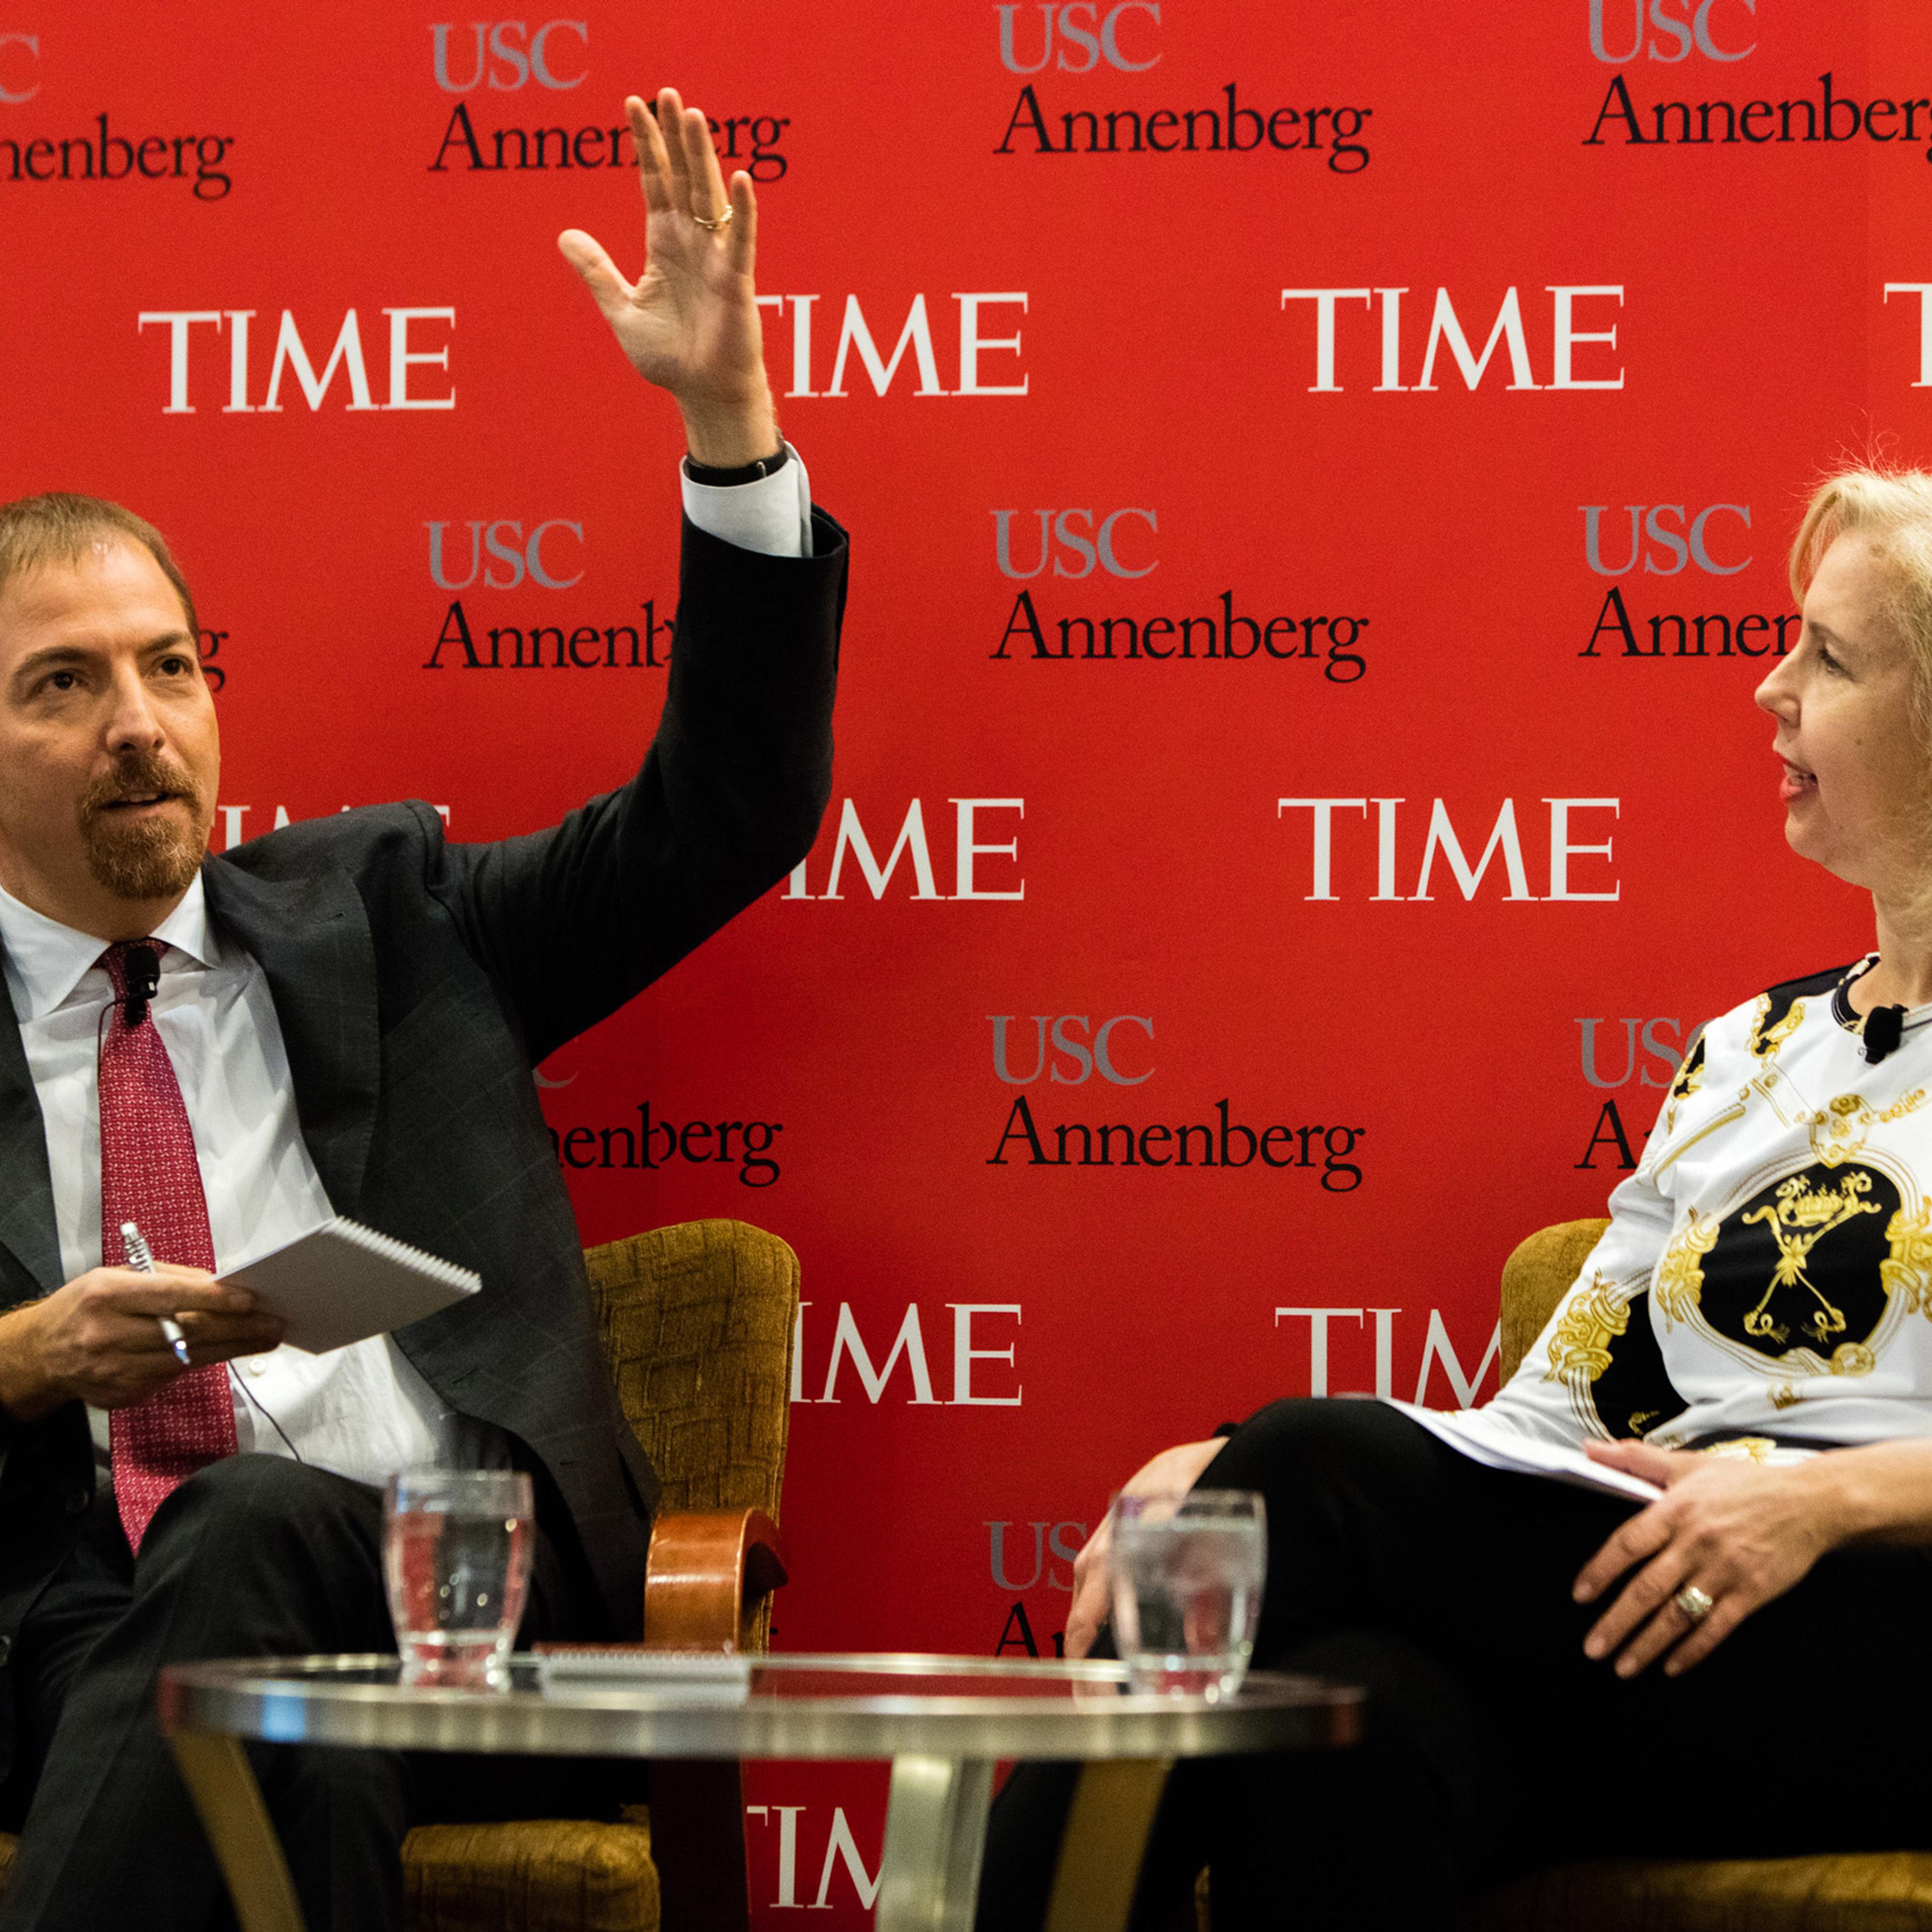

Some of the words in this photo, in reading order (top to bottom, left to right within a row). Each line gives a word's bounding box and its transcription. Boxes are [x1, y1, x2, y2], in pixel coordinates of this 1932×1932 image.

[429, 20, 588, 93] USC
[994, 1, 1163, 74] USC
[1587, 0, 1756, 63] USC
[0, 113, 233, 200] nenberg
[428, 100, 790, 182] Annenrg
[993, 83, 1373, 174] Annenberg
[1582, 71, 1932, 164] Annenber
[138, 307, 455, 413] TIME
[755, 292, 1028, 397] IME
[1281, 285, 1624, 392] TIME
[423, 519, 585, 589] USC
[989, 508, 1159, 579] USC
[1578, 504, 1752, 576] USC
[422, 599, 674, 669] Annenb
[989, 589, 1369, 683] Annenberg
[1578, 586, 1801, 657] Annen
[781, 798, 1024, 901] ME
[1278, 797, 1620, 901] TIME
[985, 1015, 1155, 1085] USC
[547, 1100, 783, 1187] enberg
[986, 1094, 1365, 1192] Annenberg
[789, 1302, 1022, 1406] IME
[1275, 1307, 1502, 1410] TIM
[983, 1521, 1087, 1591] US
[747, 1805, 882, 1910] IM
